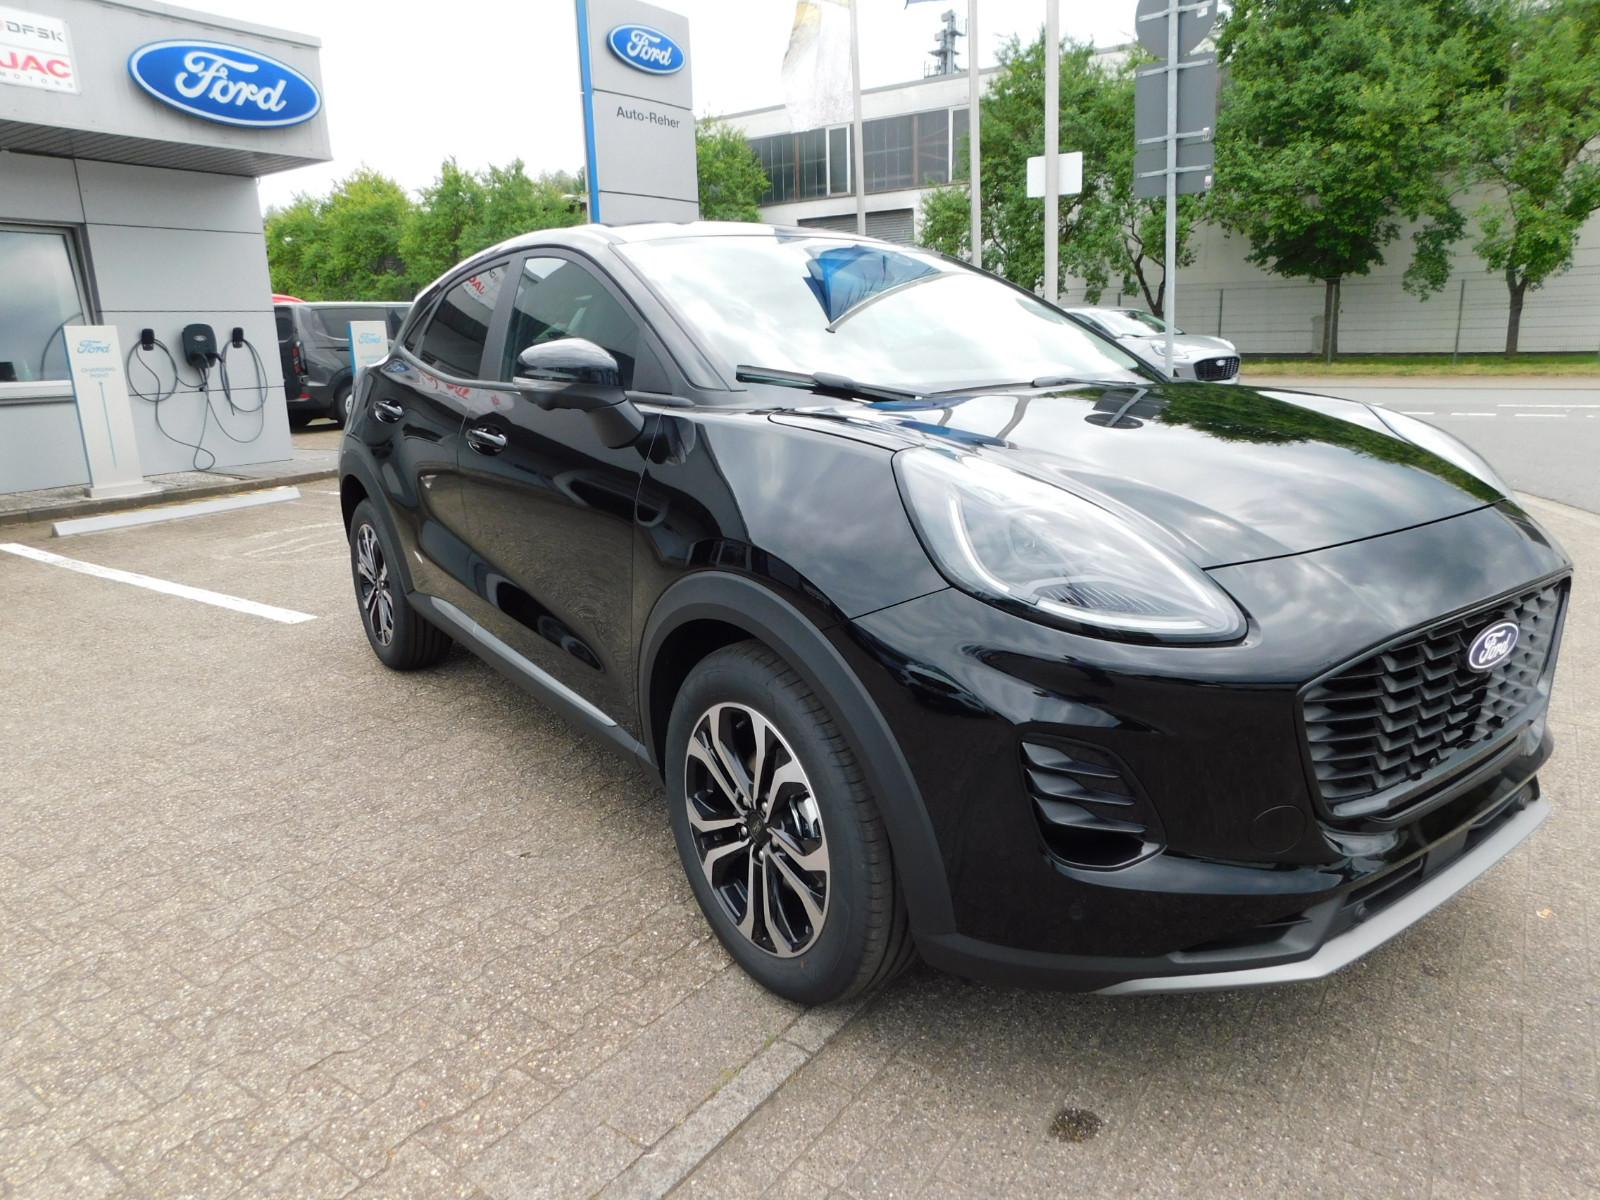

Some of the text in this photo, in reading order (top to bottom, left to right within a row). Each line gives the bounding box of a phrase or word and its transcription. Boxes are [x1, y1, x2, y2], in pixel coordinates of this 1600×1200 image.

[5, 20, 64, 42] DFSK
[626, 29, 673, 66] Ford
[0, 51, 72, 78] JAC
[174, 51, 288, 112] Ford
[616, 106, 681, 129] Auto-Reher
[76, 340, 111, 354] Ford
[1479, 629, 1512, 664] Ford
